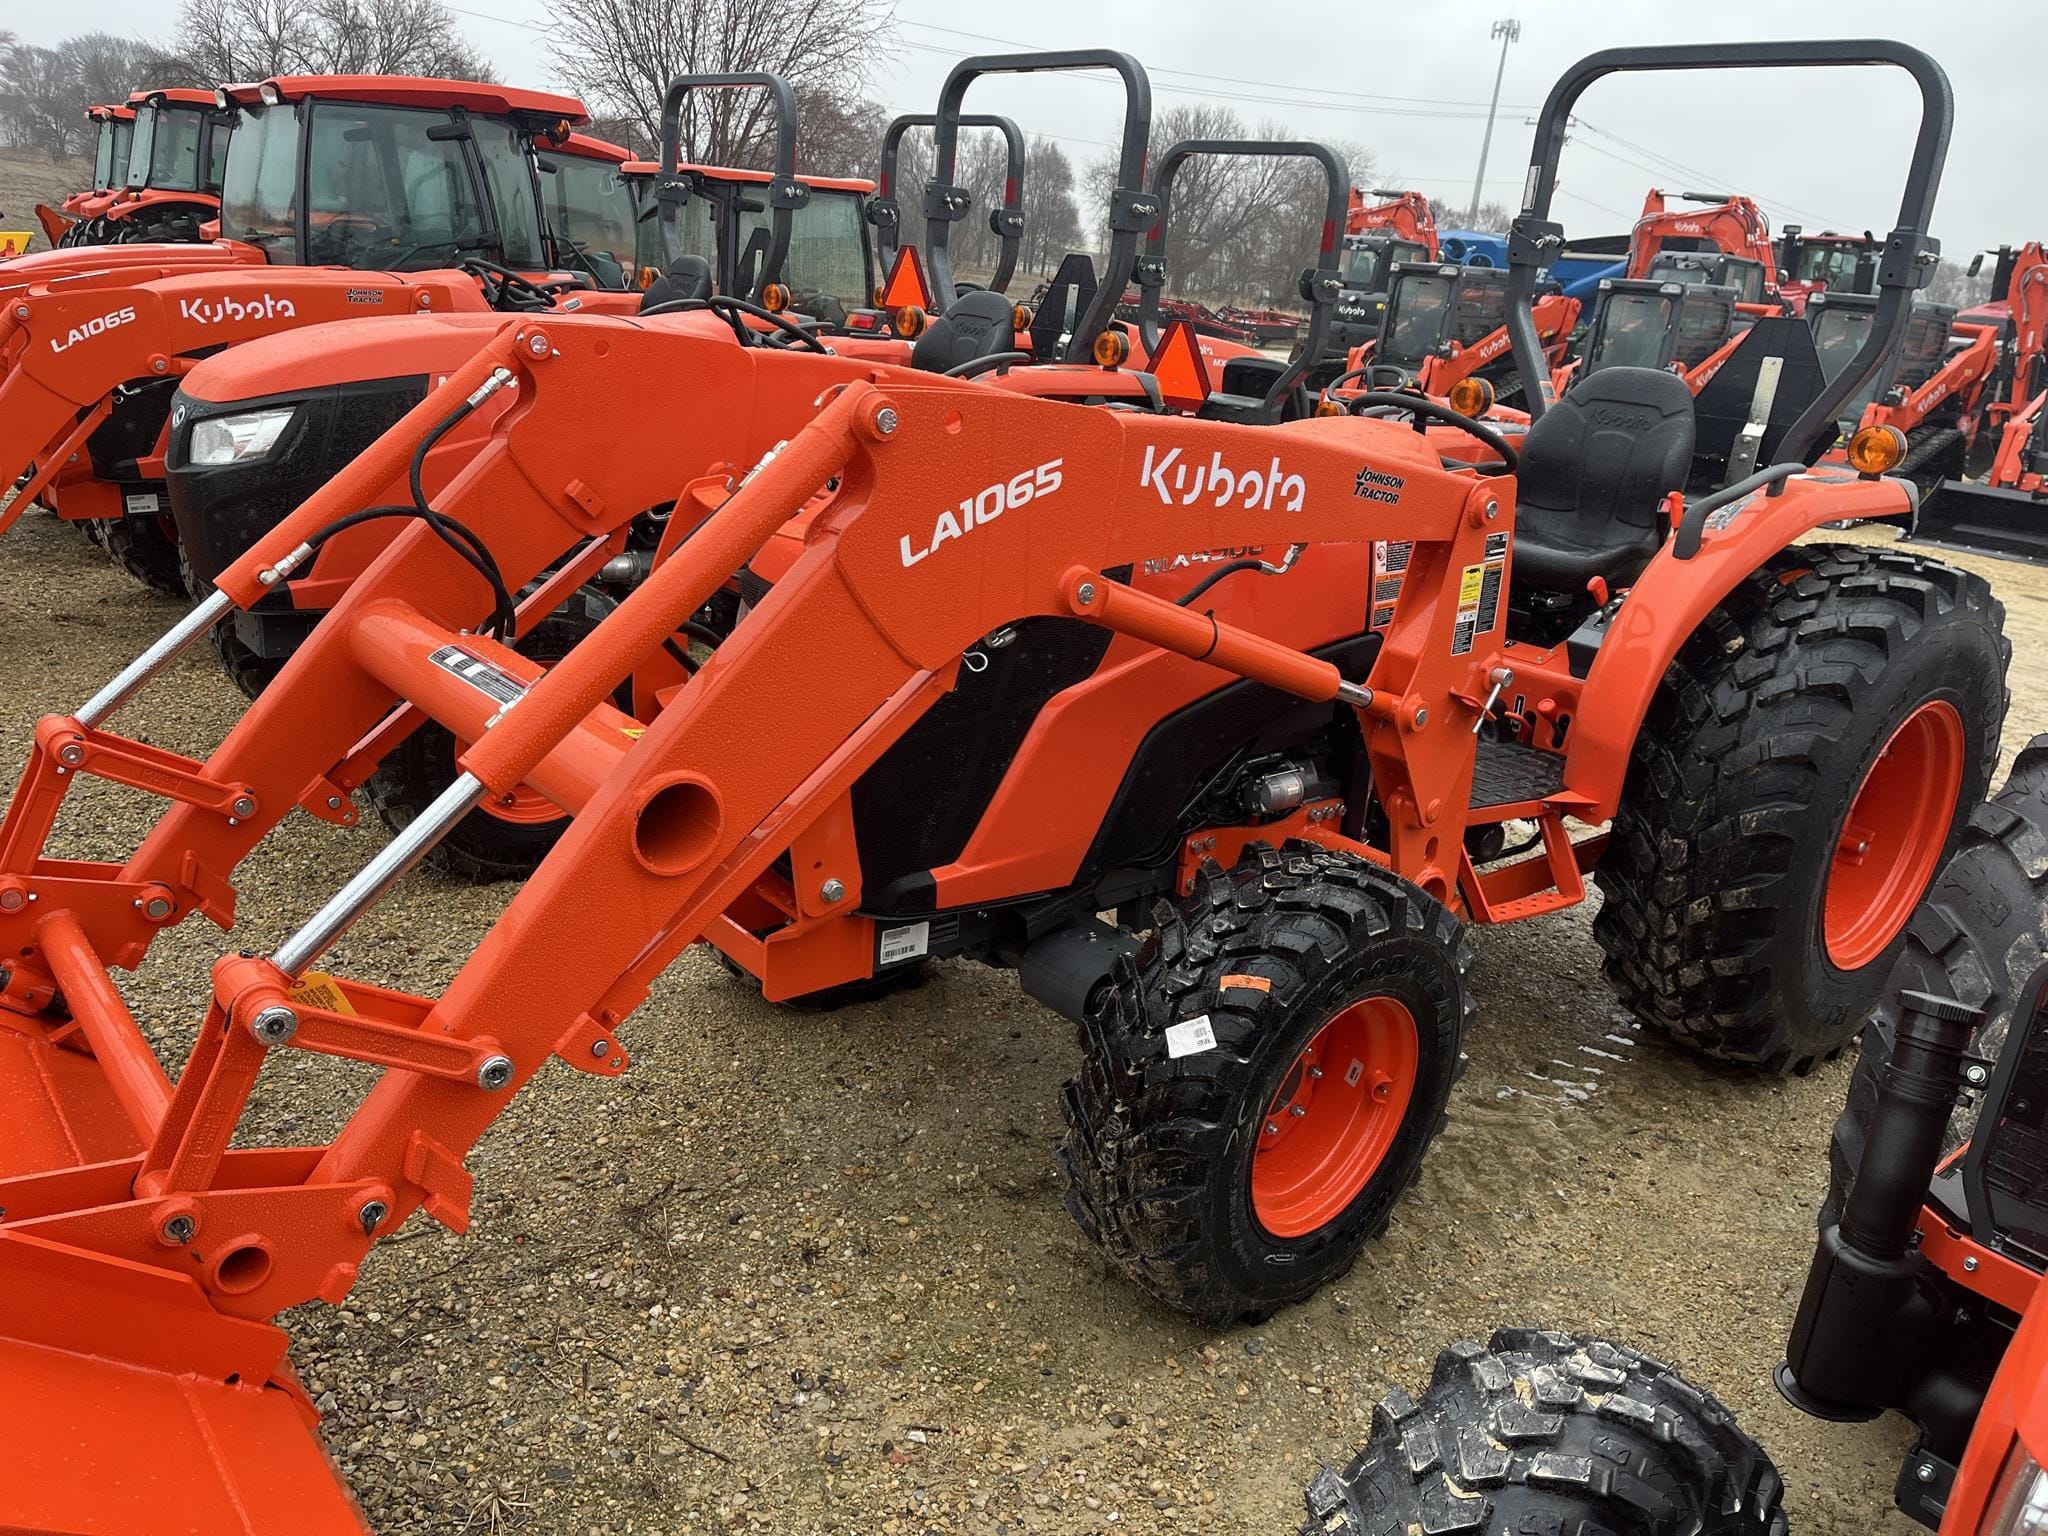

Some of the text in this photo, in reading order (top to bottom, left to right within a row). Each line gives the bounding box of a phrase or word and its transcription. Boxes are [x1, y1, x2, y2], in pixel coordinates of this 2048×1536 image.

[346, 288, 383, 296] JOHNSON
[347, 295, 383, 303] TRACTOR
[180, 292, 296, 324] Kubota
[1339, 305, 1365, 316] Kubota
[50, 306, 137, 354] LA1065
[1591, 407, 1652, 431] Kubota
[1139, 444, 1306, 513] Kubota
[1356, 465, 1405, 489] JOHNSON
[1353, 481, 1400, 505] TRACTOR
[899, 457, 1064, 568] LA1065
